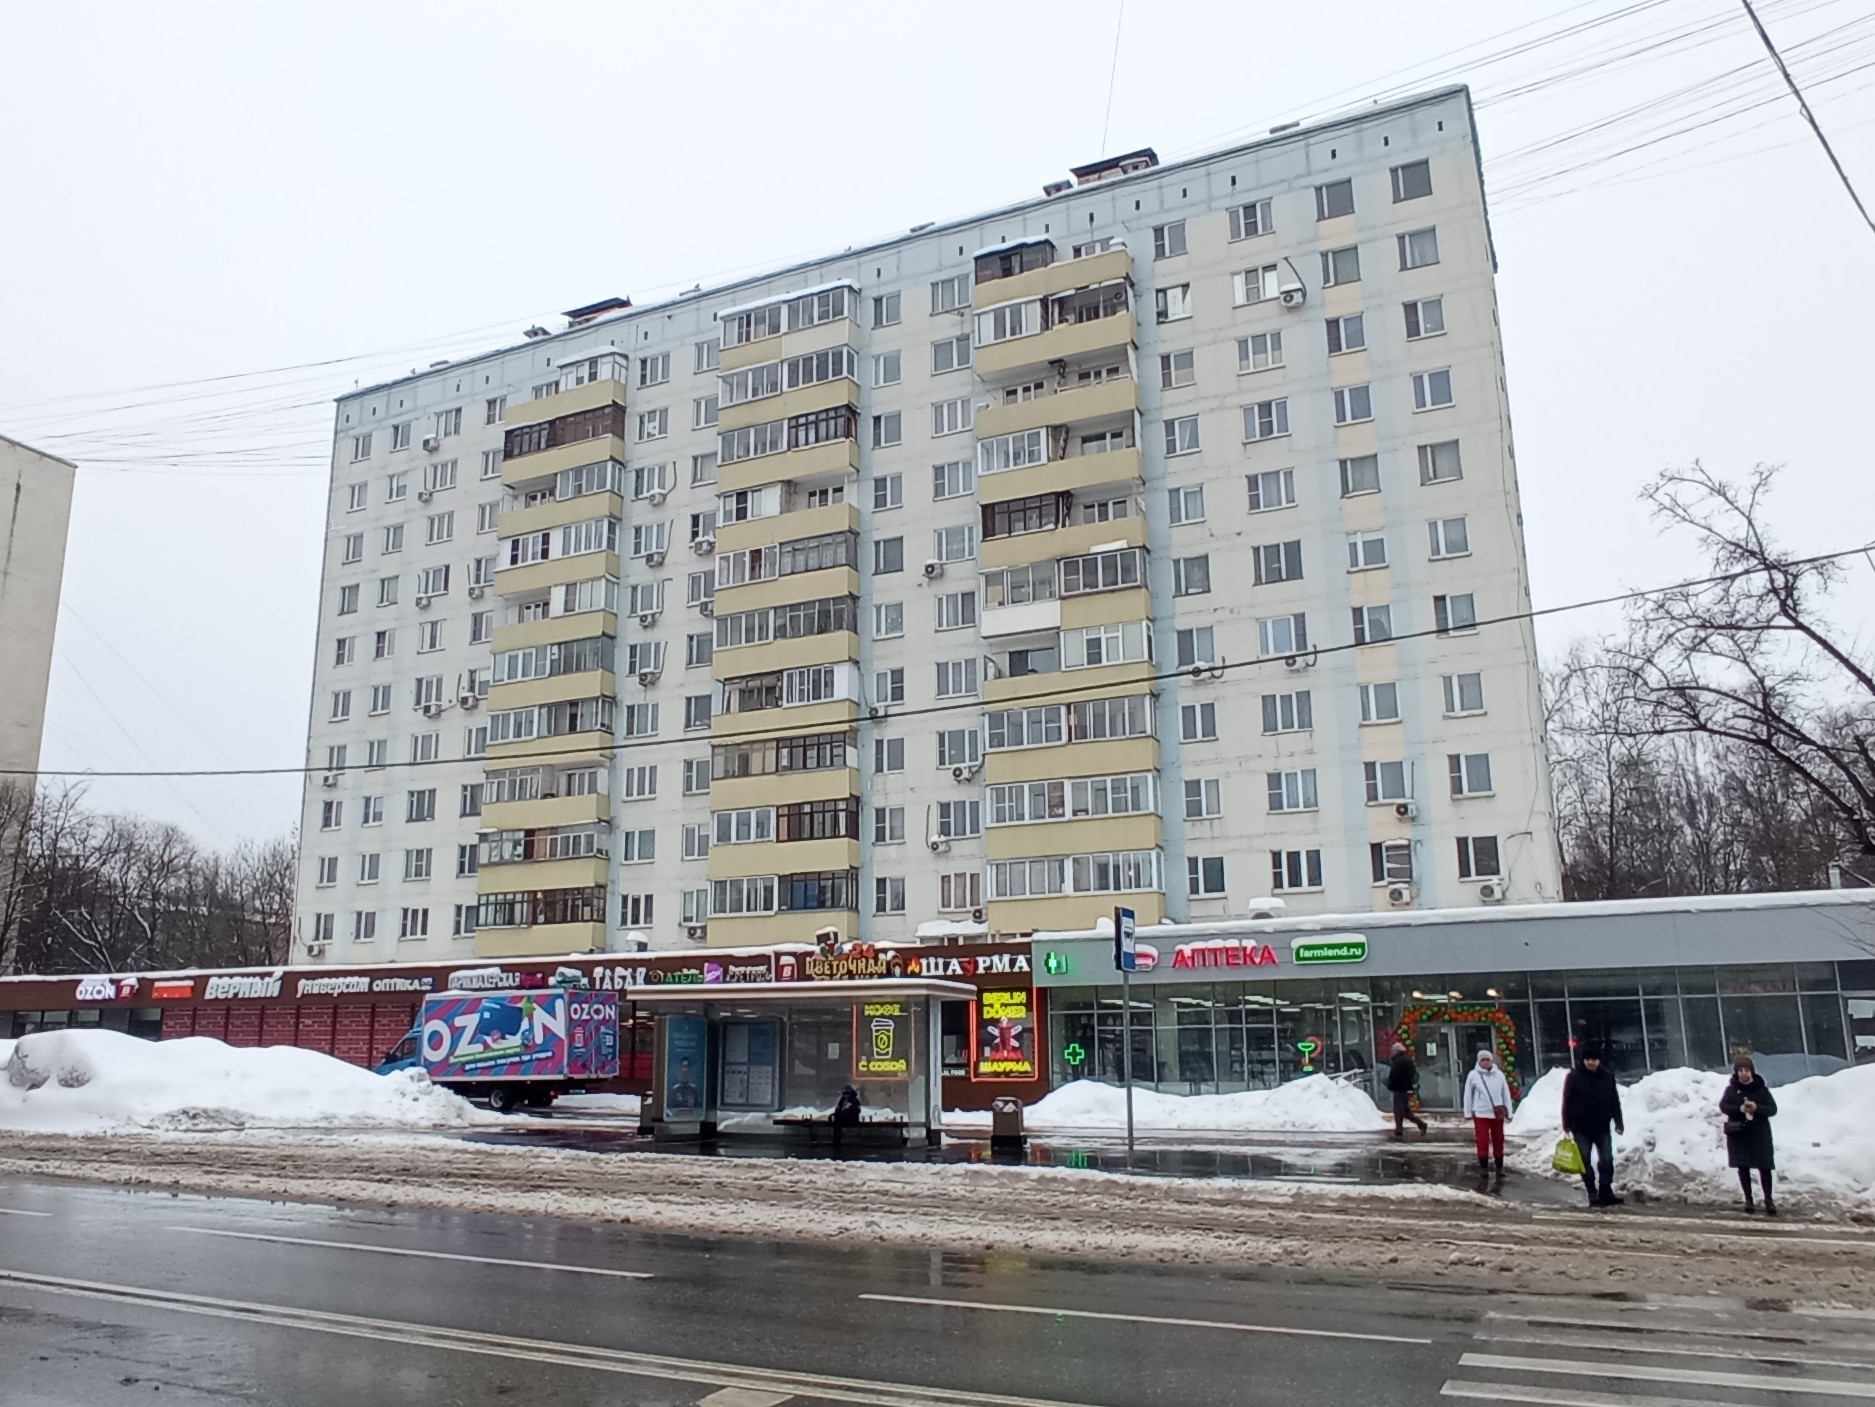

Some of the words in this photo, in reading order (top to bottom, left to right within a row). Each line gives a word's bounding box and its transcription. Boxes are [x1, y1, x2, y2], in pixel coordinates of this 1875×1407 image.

[1172, 943, 1280, 969] АПТЕКА
[1299, 946, 1362, 957] farmlend.ru
[805, 957, 887, 977] ЦВЕТОЧНАЯ
[920, 955, 1031, 977] ШАУРМА
[372, 978, 420, 991] ОПТИКА
[593, 966, 647, 990] ТАБАК
[76, 983, 116, 1000] OZON
[570, 1003, 617, 1020] OZON
[864, 1004, 901, 1016] КОФЕ
[979, 1061, 1032, 1072] ШАУРМА
